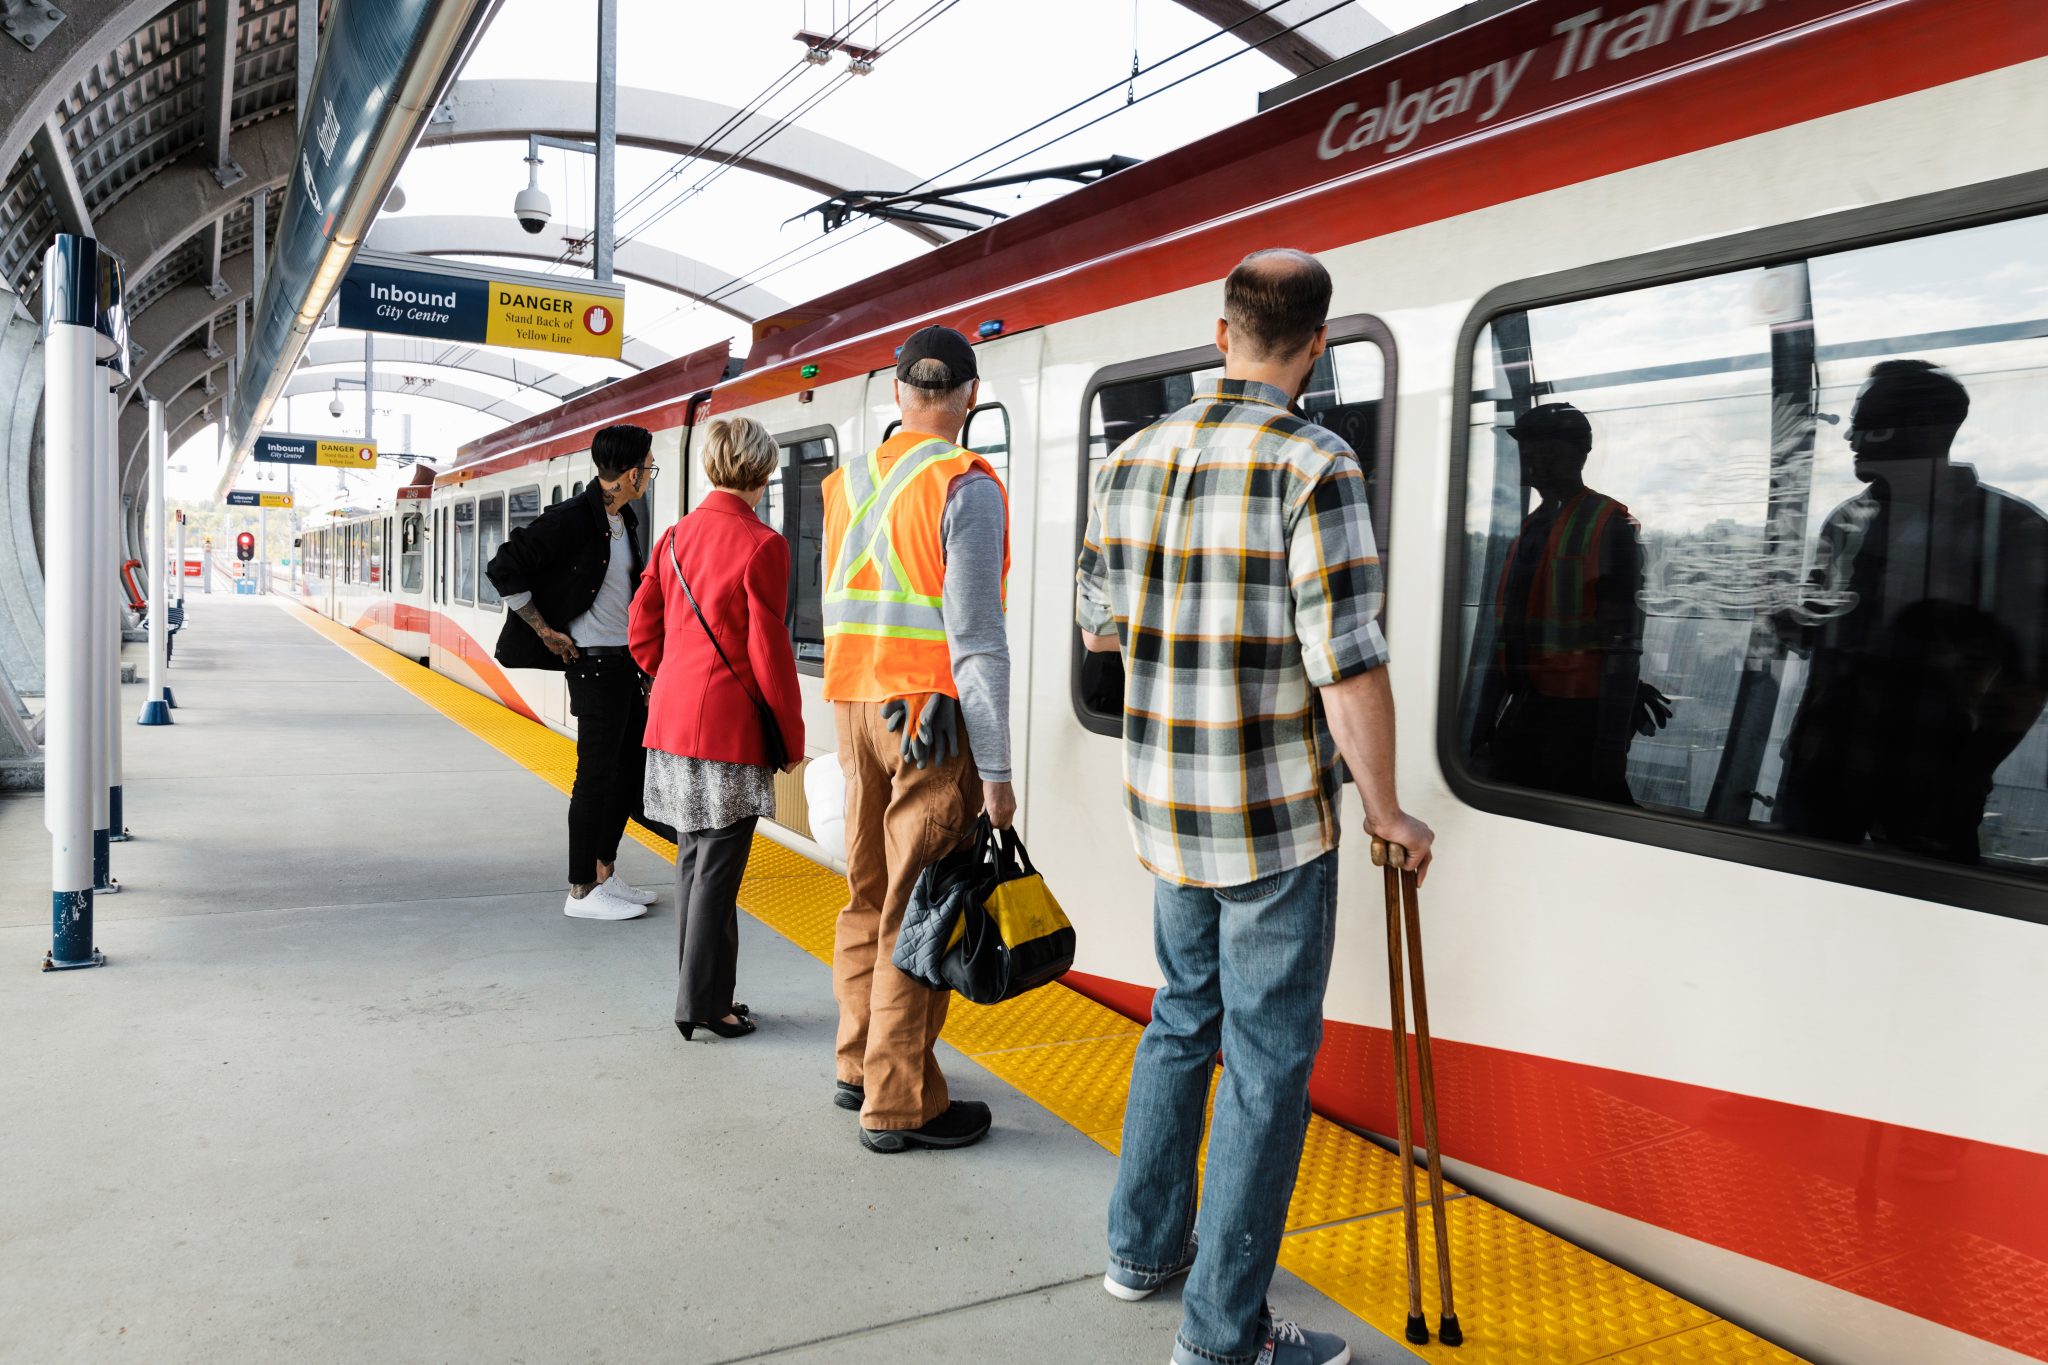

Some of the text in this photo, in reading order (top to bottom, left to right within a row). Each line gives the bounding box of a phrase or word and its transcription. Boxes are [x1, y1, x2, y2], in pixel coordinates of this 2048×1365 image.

[1317, 46, 1535, 160] Calgary
[370, 282, 457, 309] Inbound
[499, 292, 573, 314] DANGER
[376, 304, 450, 323] City Centre
[505, 312, 574, 329] Stand Back of
[516, 329, 572, 344] Yellow Line
[267, 443, 305, 453] Inbound
[270, 451, 281, 459] City
[321, 444, 355, 452] DANGER
